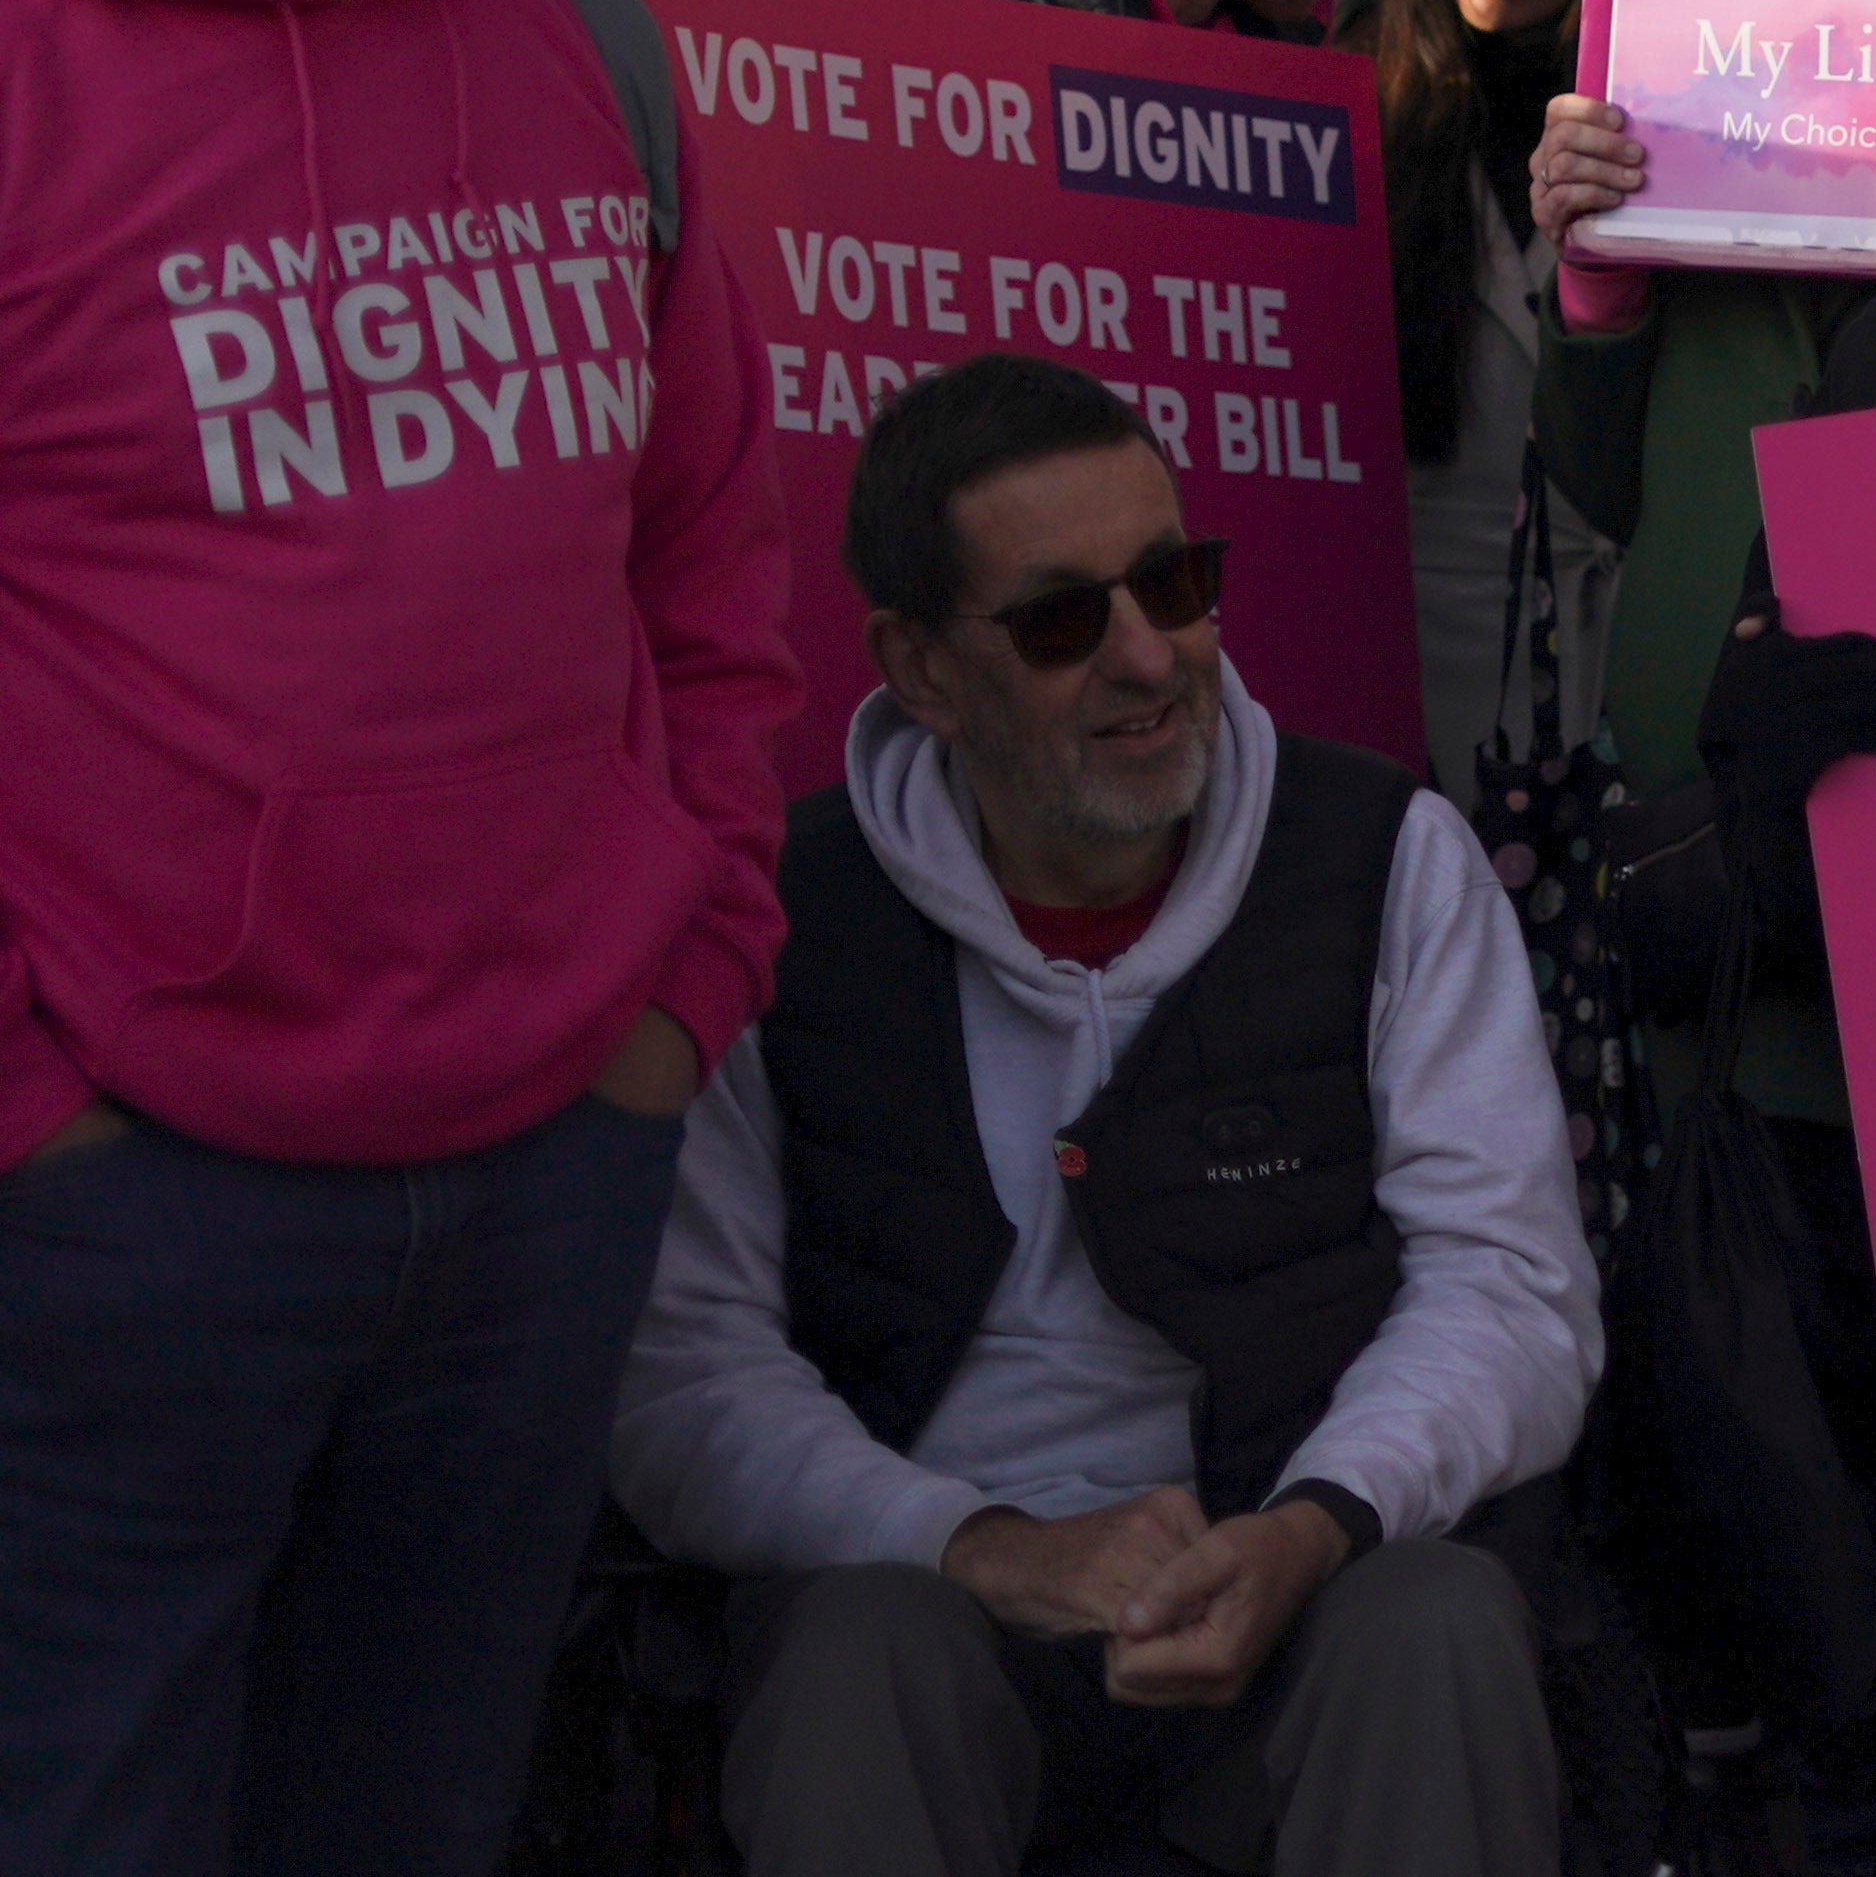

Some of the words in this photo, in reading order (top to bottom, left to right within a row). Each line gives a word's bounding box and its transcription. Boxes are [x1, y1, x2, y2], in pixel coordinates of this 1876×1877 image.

[1693, 19, 1792, 98] My
[675, 26, 869, 142] VOTE
[892, 64, 1036, 165] FOR
[1059, 88, 1339, 204] DIGNITY
[1722, 113, 1773, 150] My
[776, 227, 966, 336] VOTE
[990, 255, 1131, 352] FOR
[1154, 274, 1292, 369] THE
[198, 400, 349, 513] IN
[1215, 391, 1362, 482] BILL
